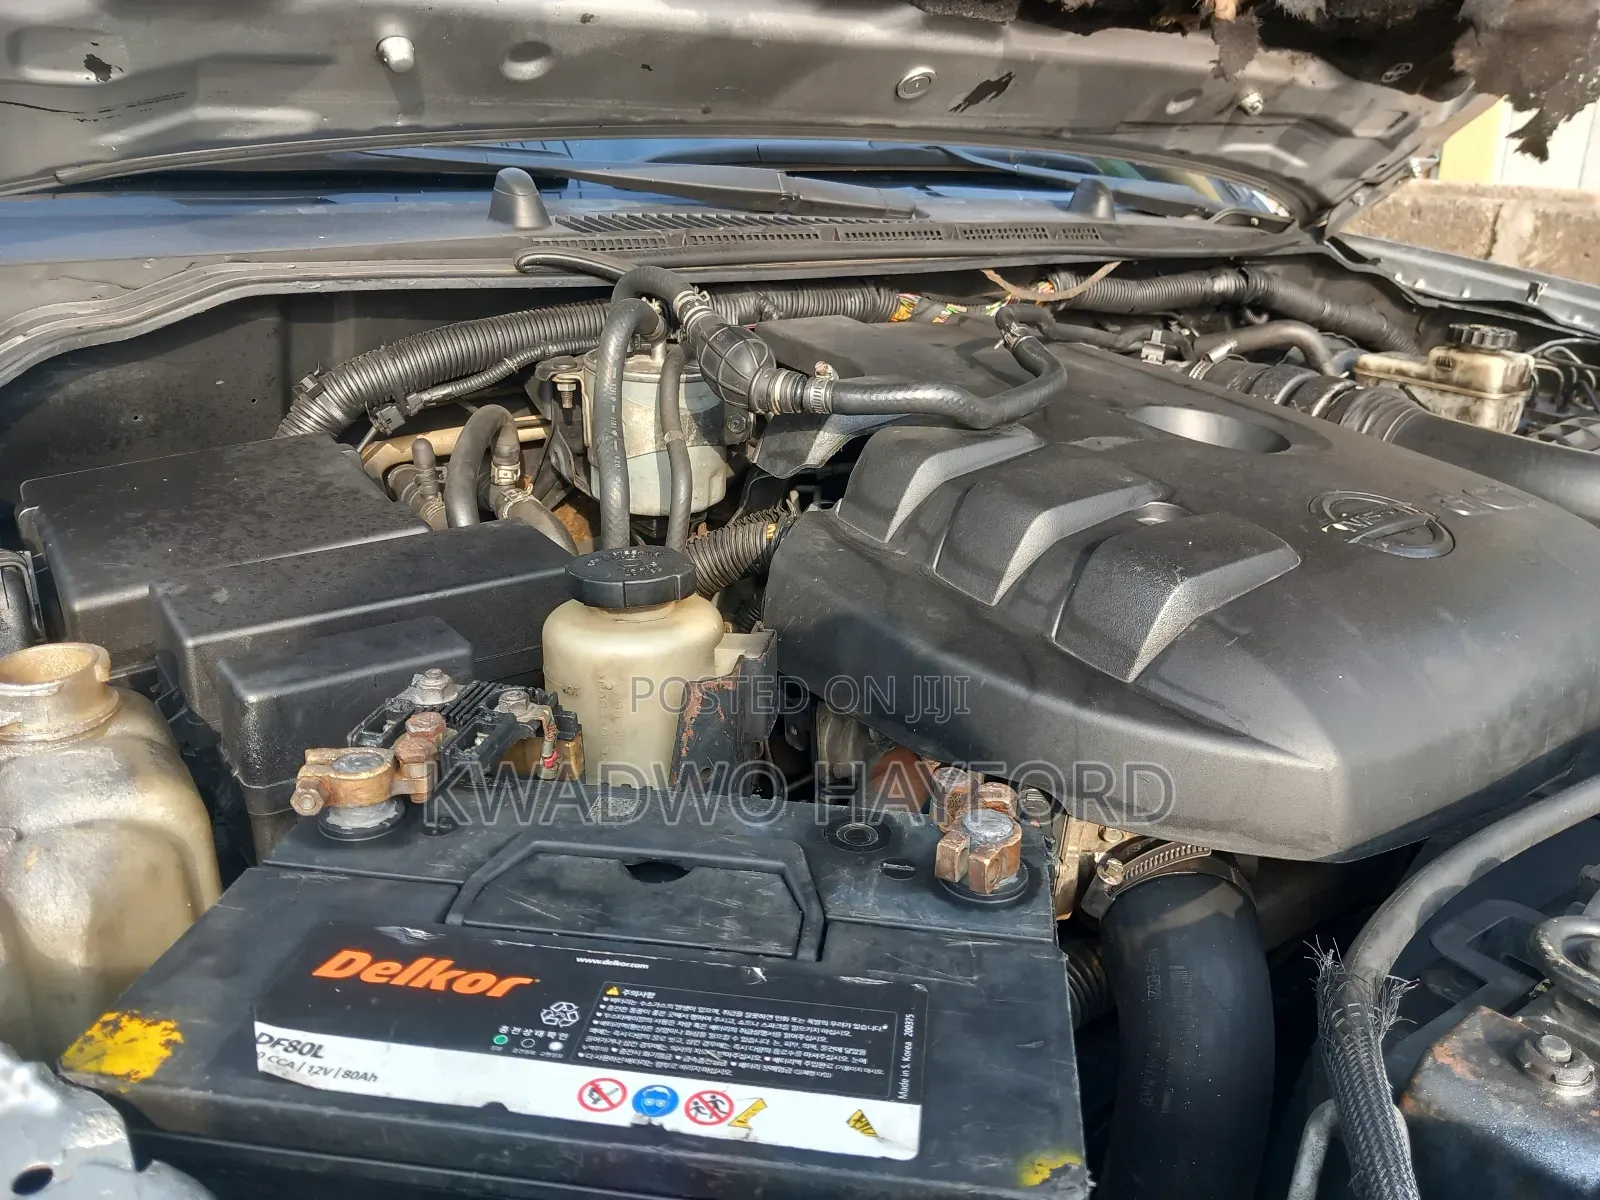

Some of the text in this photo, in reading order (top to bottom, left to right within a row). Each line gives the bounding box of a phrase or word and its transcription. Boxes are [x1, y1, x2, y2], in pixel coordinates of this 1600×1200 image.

[311, 948, 535, 998] Delkor
[576, 956, 650, 970] www.delkor.com
[622, 989, 656, 998] 주의사항
[255, 1031, 325, 1059] DF80L
[901, 1041, 912, 1062] Korea
[268, 1054, 296, 1070] CCA
[307, 1064, 333, 1077] 12V
[342, 1069, 379, 1083] 80Ah
[898, 1078, 909, 1099] Made
